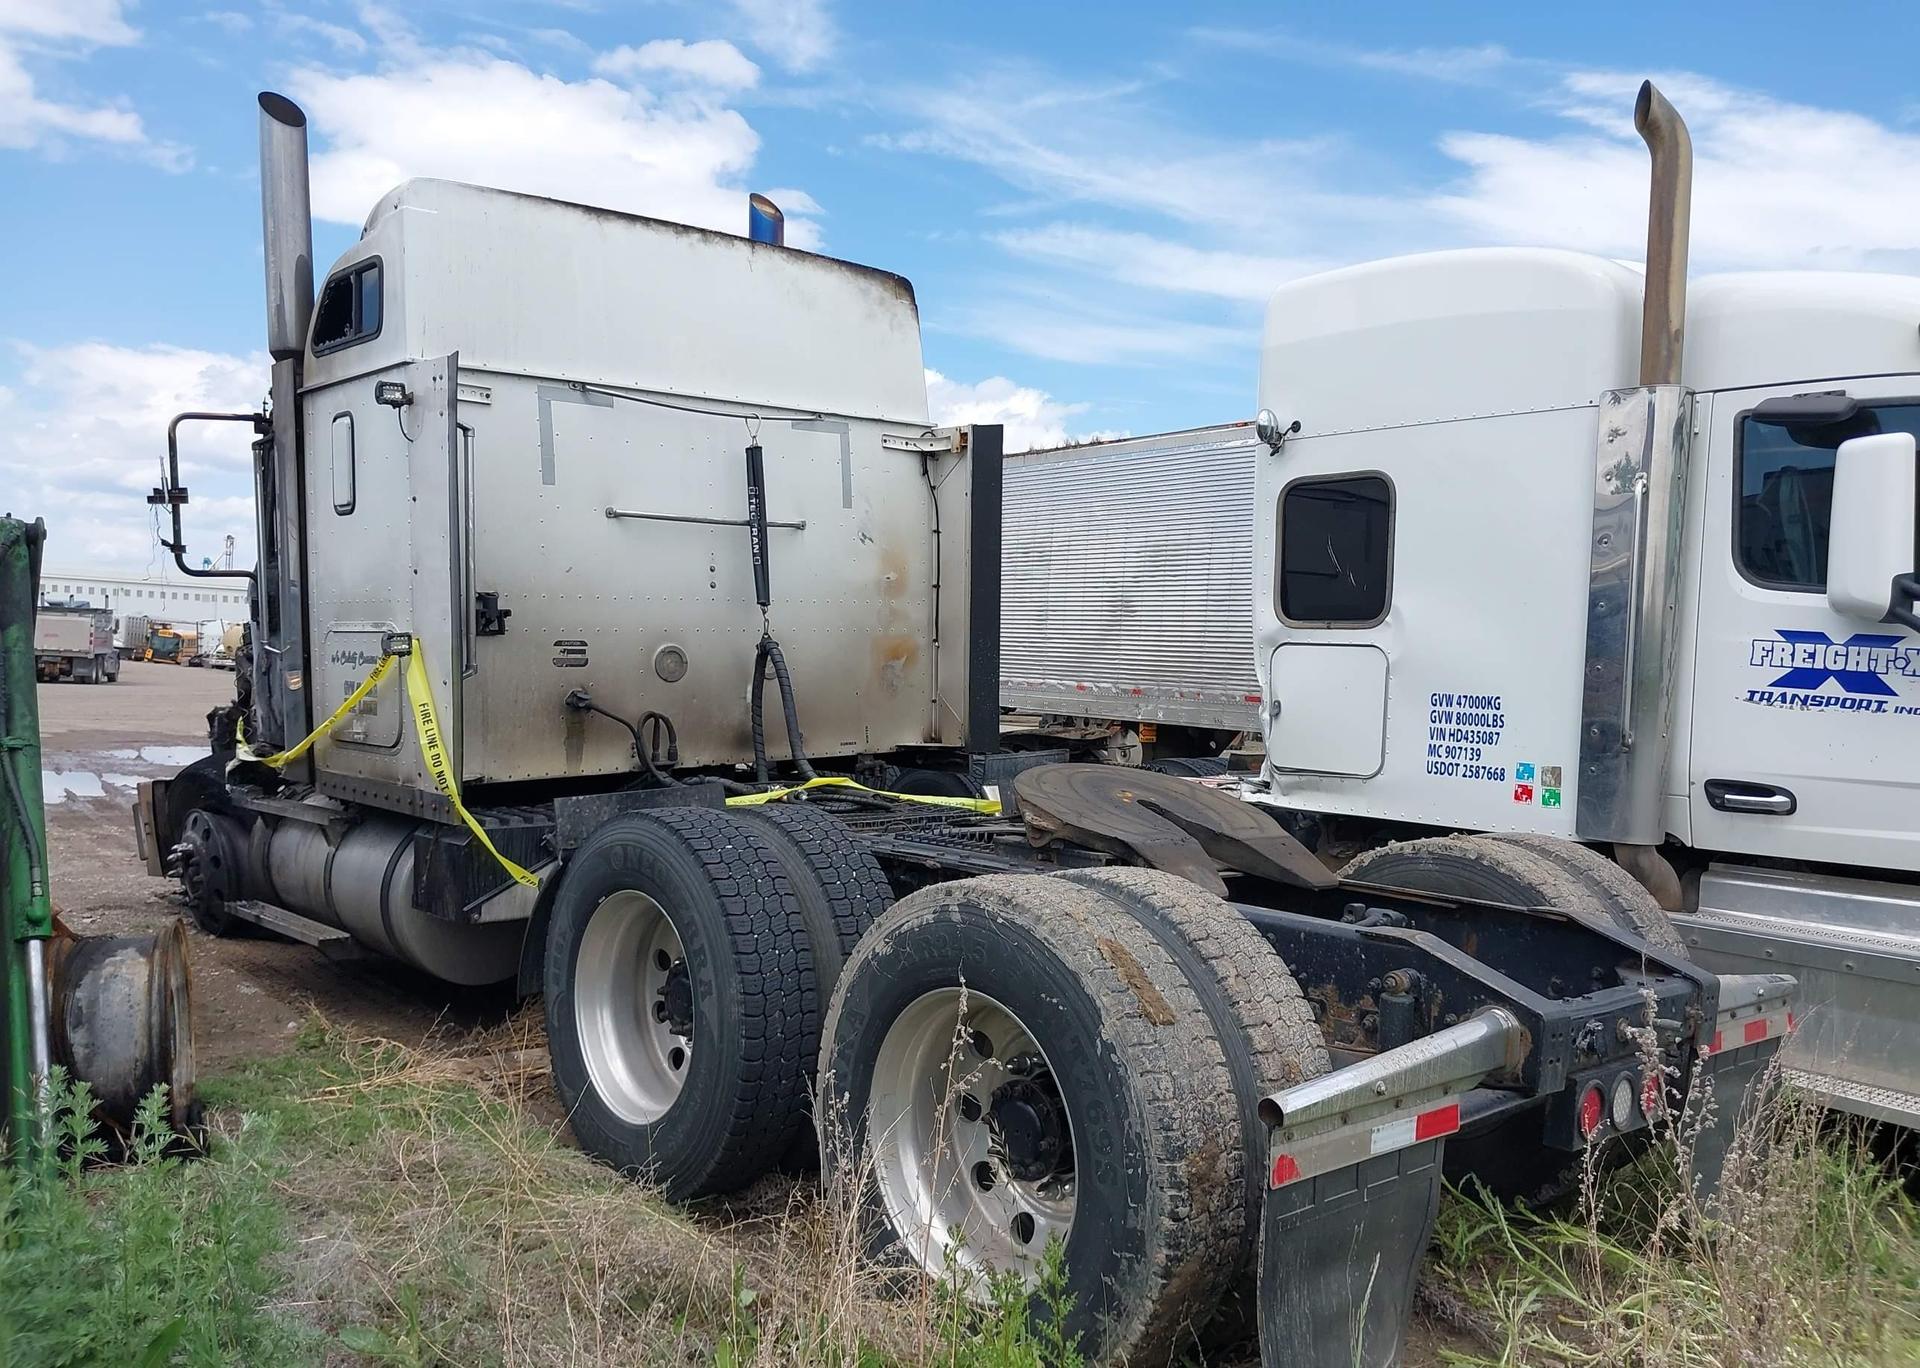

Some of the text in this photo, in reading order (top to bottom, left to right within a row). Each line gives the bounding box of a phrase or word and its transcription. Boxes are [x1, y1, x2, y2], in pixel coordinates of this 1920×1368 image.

[1430, 693, 1501, 711] GVW 47000KG
[1746, 689, 1889, 713] TRANSPORT
[1429, 710, 1505, 729] GVW 80000LBS
[1429, 727, 1500, 746] VIN HD435087
[419, 703, 450, 793] FIRE LINE DO NOT
[1427, 744, 1481, 762] MC 907139
[1426, 760, 1506, 782] USDOT 2587668
